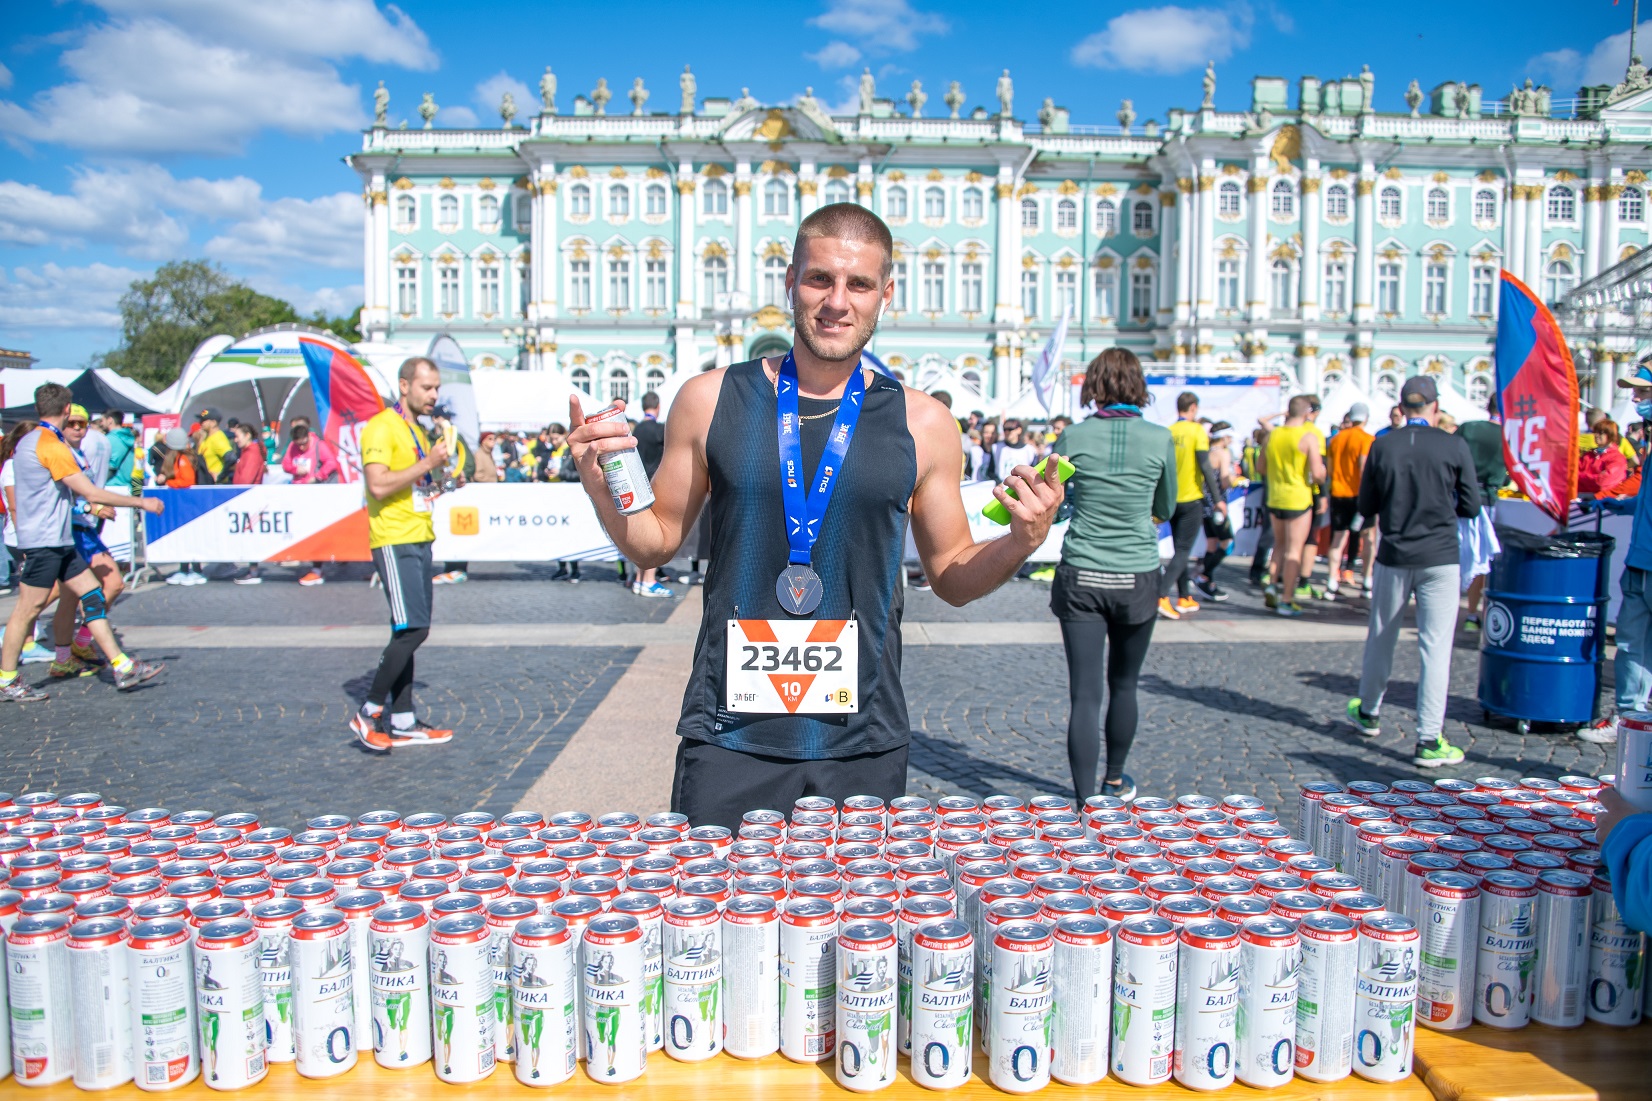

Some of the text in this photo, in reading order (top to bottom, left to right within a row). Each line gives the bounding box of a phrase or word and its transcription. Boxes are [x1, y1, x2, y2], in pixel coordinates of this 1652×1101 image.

[819, 477, 829, 493] ПСБ
[490, 515, 569, 526] MYBOOK
[1522, 616, 1595, 628] ПЕРЕРАБОТАТЬ
[1521, 625, 1557, 635] БАНКИ
[1521, 634, 1555, 644] ЗДЕСЬ
[741, 646, 842, 671] 23462
[781, 682, 801, 696] 10
[839, 691, 848, 702] B
[1488, 886, 1511, 896] СТАРТУЙТЕ
[1227, 914, 1245, 923] СТАРТУЙ
[1433, 912, 1441, 923] 0
[1126, 934, 1142, 943] ПРИЗАМИ
[1592, 932, 1640, 947] БАЛТИ
[1009, 942, 1032, 951] СТАРТУЙТЕ
[667, 964, 721, 981] БАЛТИКА
[319, 975, 352, 994] БАЛТ
[1115, 983, 1136, 999] ИКА
[1358, 979, 1416, 997] БАЛТИКА
[199, 995, 223, 1006] ИКА
[838, 992, 893, 1007] БАЛТИКА
[1009, 994, 1051, 1009] БАЛТИ
[1206, 994, 1237, 1006] БАЛТ
[1271, 991, 1298, 1003] БАЛТ
[1485, 982, 1511, 1017] 0
[1590, 978, 1616, 1013] 0
[671, 1014, 692, 1050] 0
[1357, 1029, 1382, 1067] 0
[840, 1040, 860, 1078] 0
[924, 1041, 949, 1078] 0
[1012, 1045, 1037, 1082] 0
[1207, 1042, 1230, 1079] 0
[1272, 1038, 1292, 1075] 0
